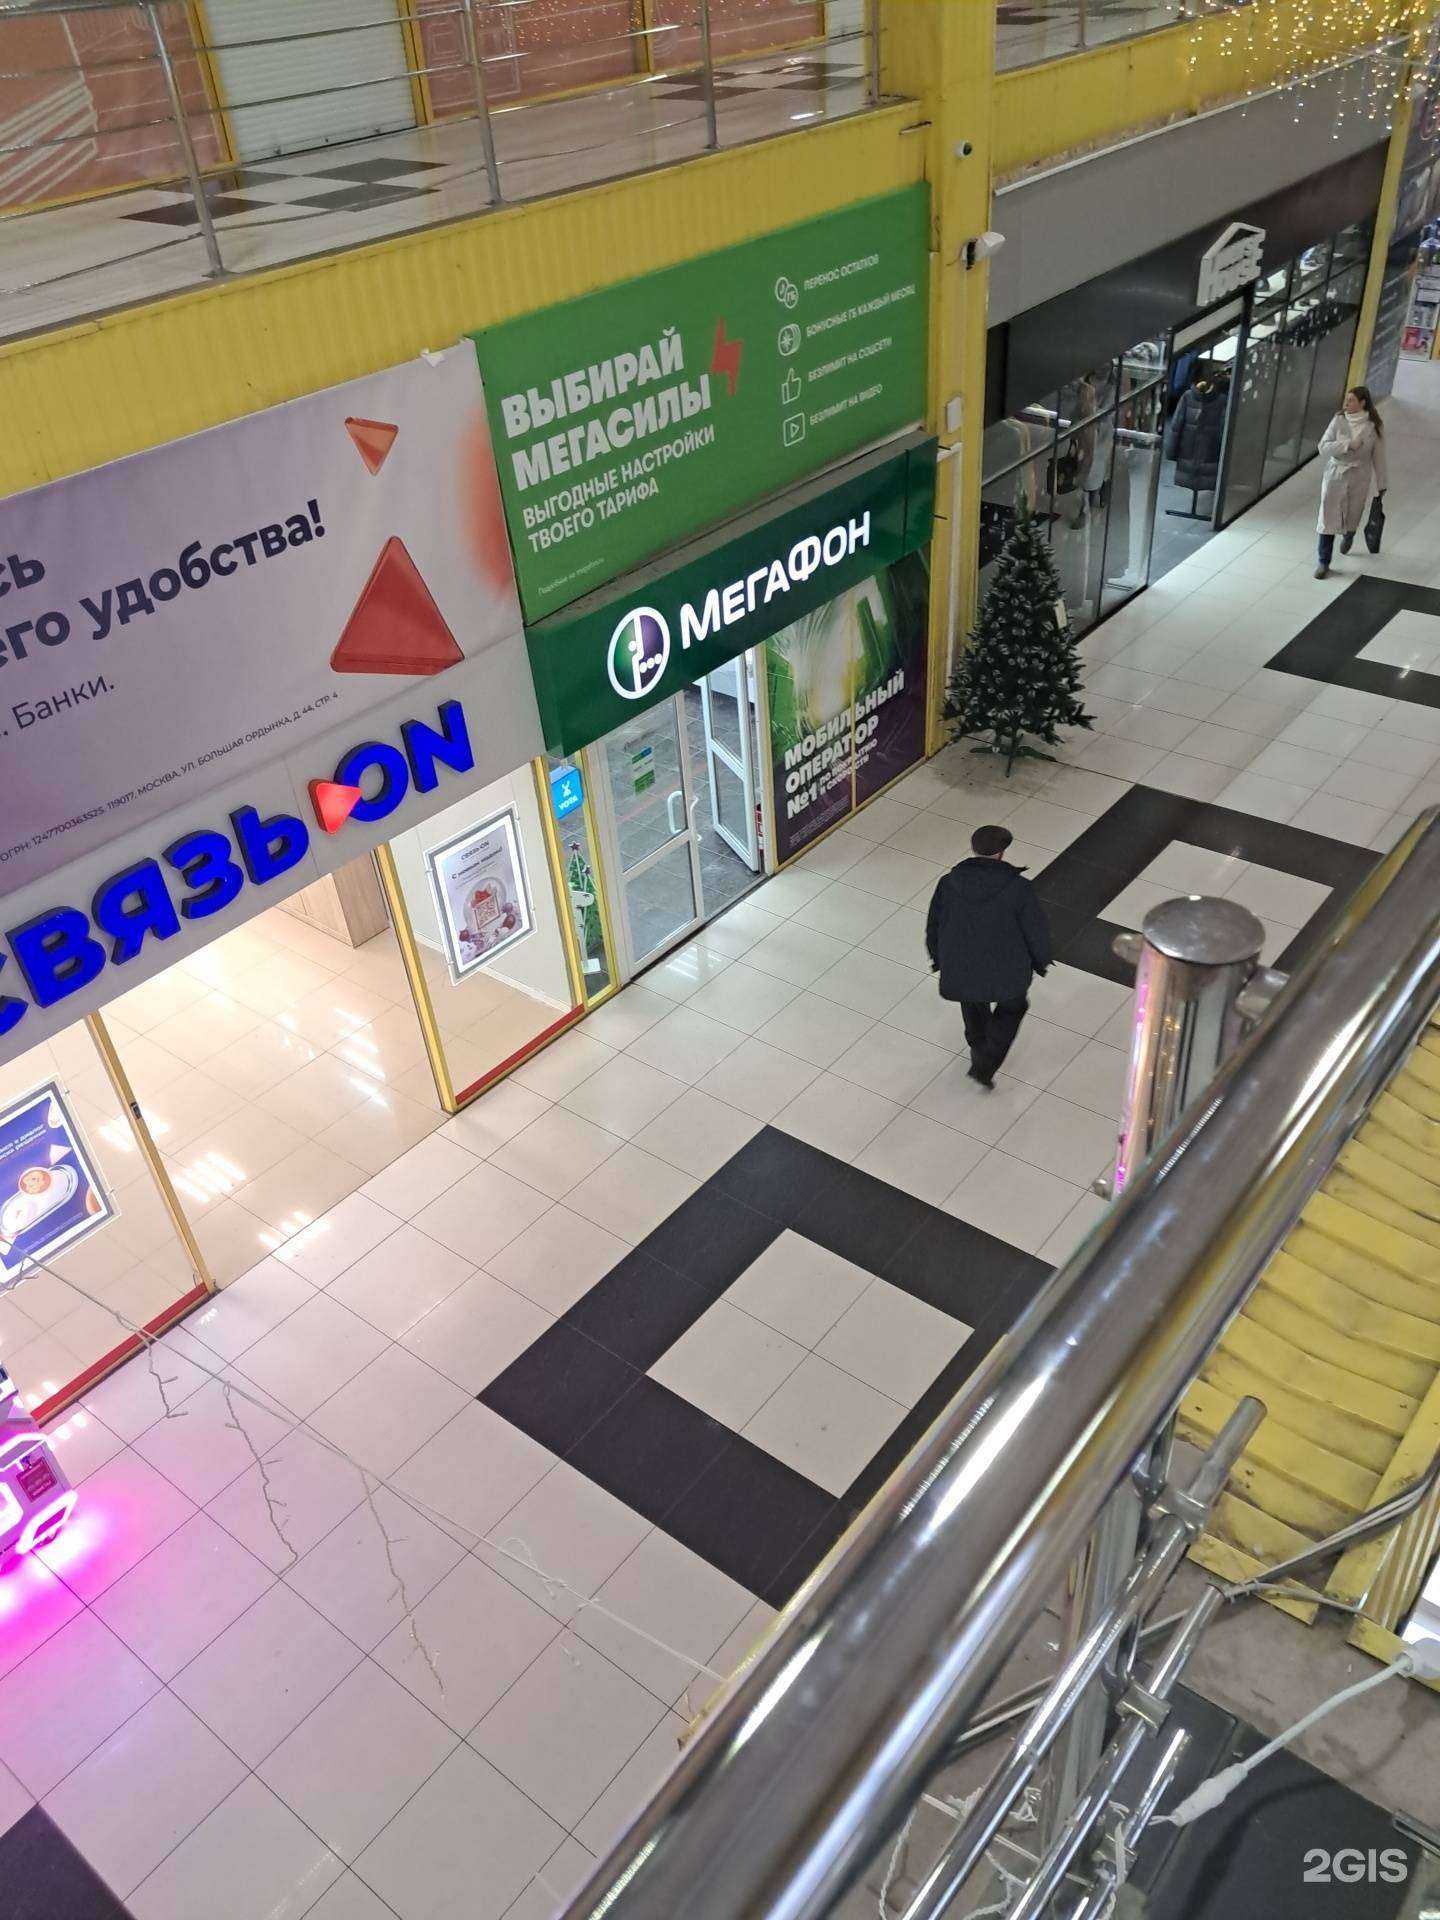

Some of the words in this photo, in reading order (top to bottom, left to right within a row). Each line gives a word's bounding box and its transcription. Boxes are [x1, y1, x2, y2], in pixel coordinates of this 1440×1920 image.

[501, 326, 684, 438] ВЫБИРАЙ
[511, 373, 711, 491] МЕГАСИЛЫ
[523, 468, 619, 529] ВЫГОДНЫЕ
[621, 424, 715, 483] НАСТРОЙКИ
[528, 507, 594, 553] ТВОЕГО
[597, 477, 659, 520] ТАРИФА
[0, 611, 70, 668] го
[79, 499, 325, 640] удобства!
[679, 511, 871, 650] МЕГАФОН
[11, 676, 115, 729] Банки.
[197, 738, 244, 767] БОЛЬШАЯ
[245, 716, 293, 743] ОРДЫНКА,
[784, 668, 905, 770] МОБИЛЬНЫЙ
[785, 714, 879, 794] ОПЕРАТОР
[786, 782, 818, 820] №1
